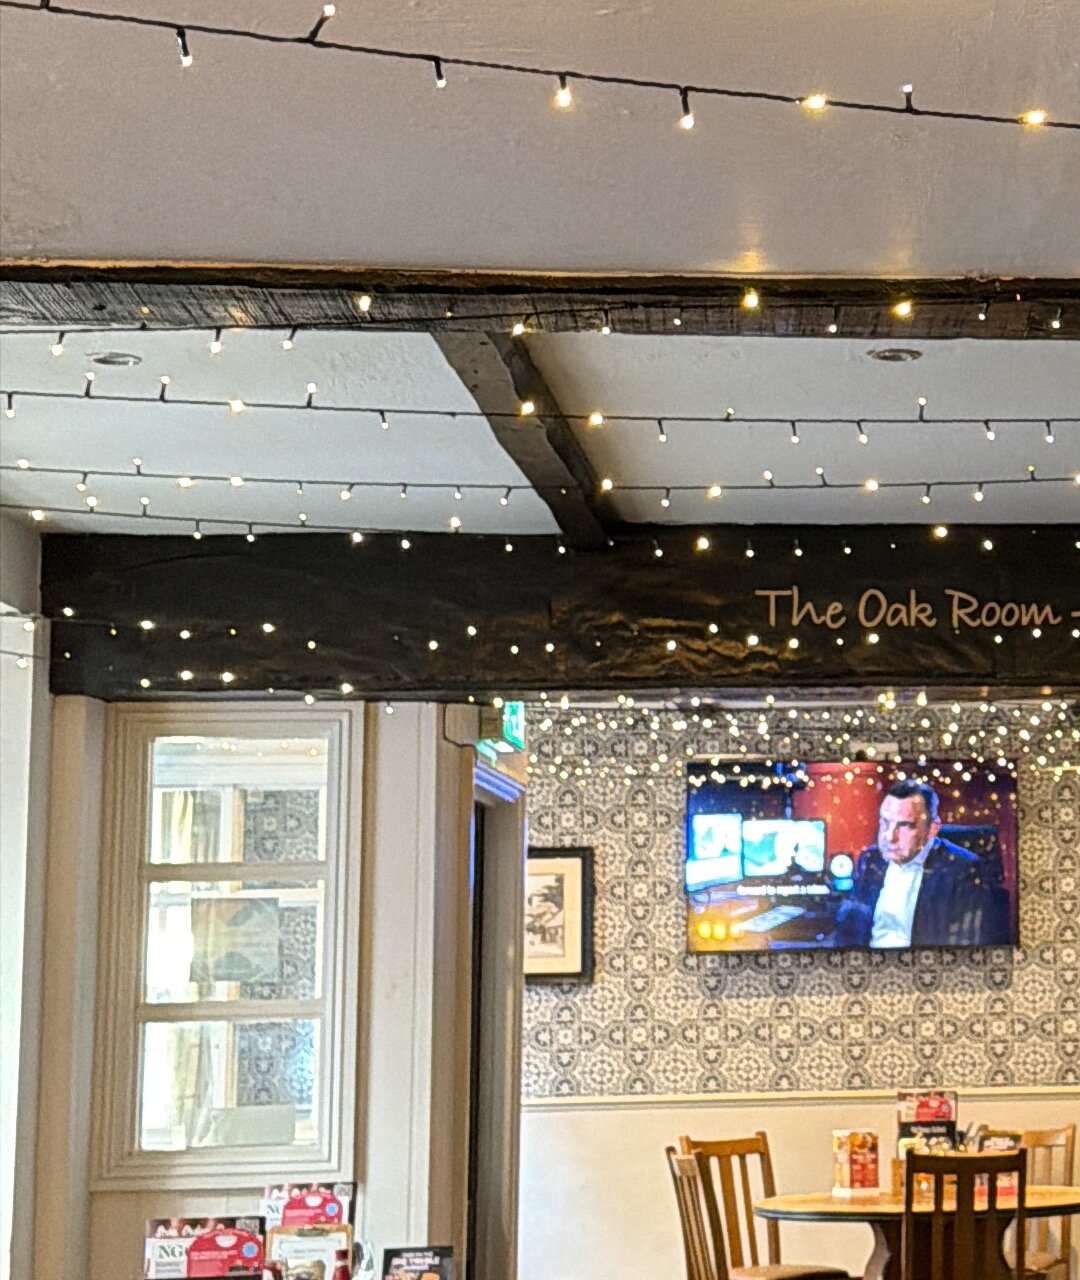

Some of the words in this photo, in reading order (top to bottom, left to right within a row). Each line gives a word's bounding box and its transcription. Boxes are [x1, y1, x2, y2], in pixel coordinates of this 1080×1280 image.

[755, 585, 847, 628] The
[858, 588, 937, 628] Oak
[944, 588, 1063, 628] Room
